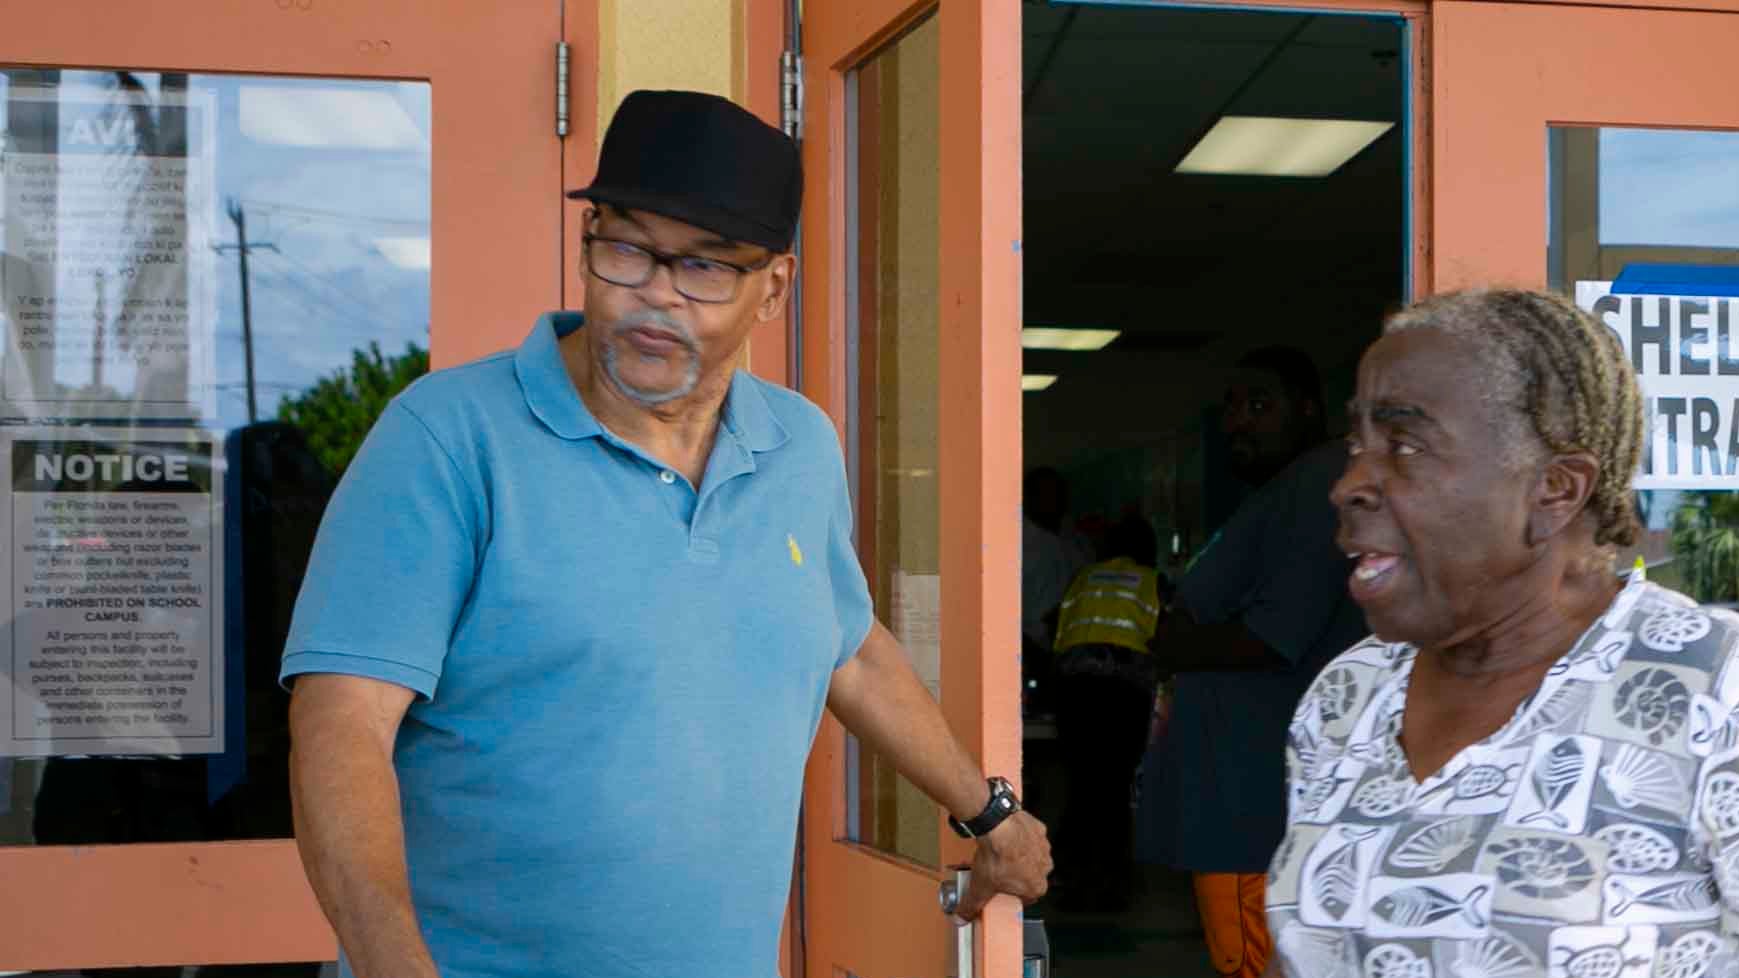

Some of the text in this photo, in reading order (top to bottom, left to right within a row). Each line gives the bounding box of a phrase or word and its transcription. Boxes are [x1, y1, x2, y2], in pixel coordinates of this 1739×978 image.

[35, 455, 189, 481] NOTICE
[46, 598, 124, 608] PROHIBITED
[126, 598, 145, 608] ON
[148, 598, 201, 608] SCHOOL
